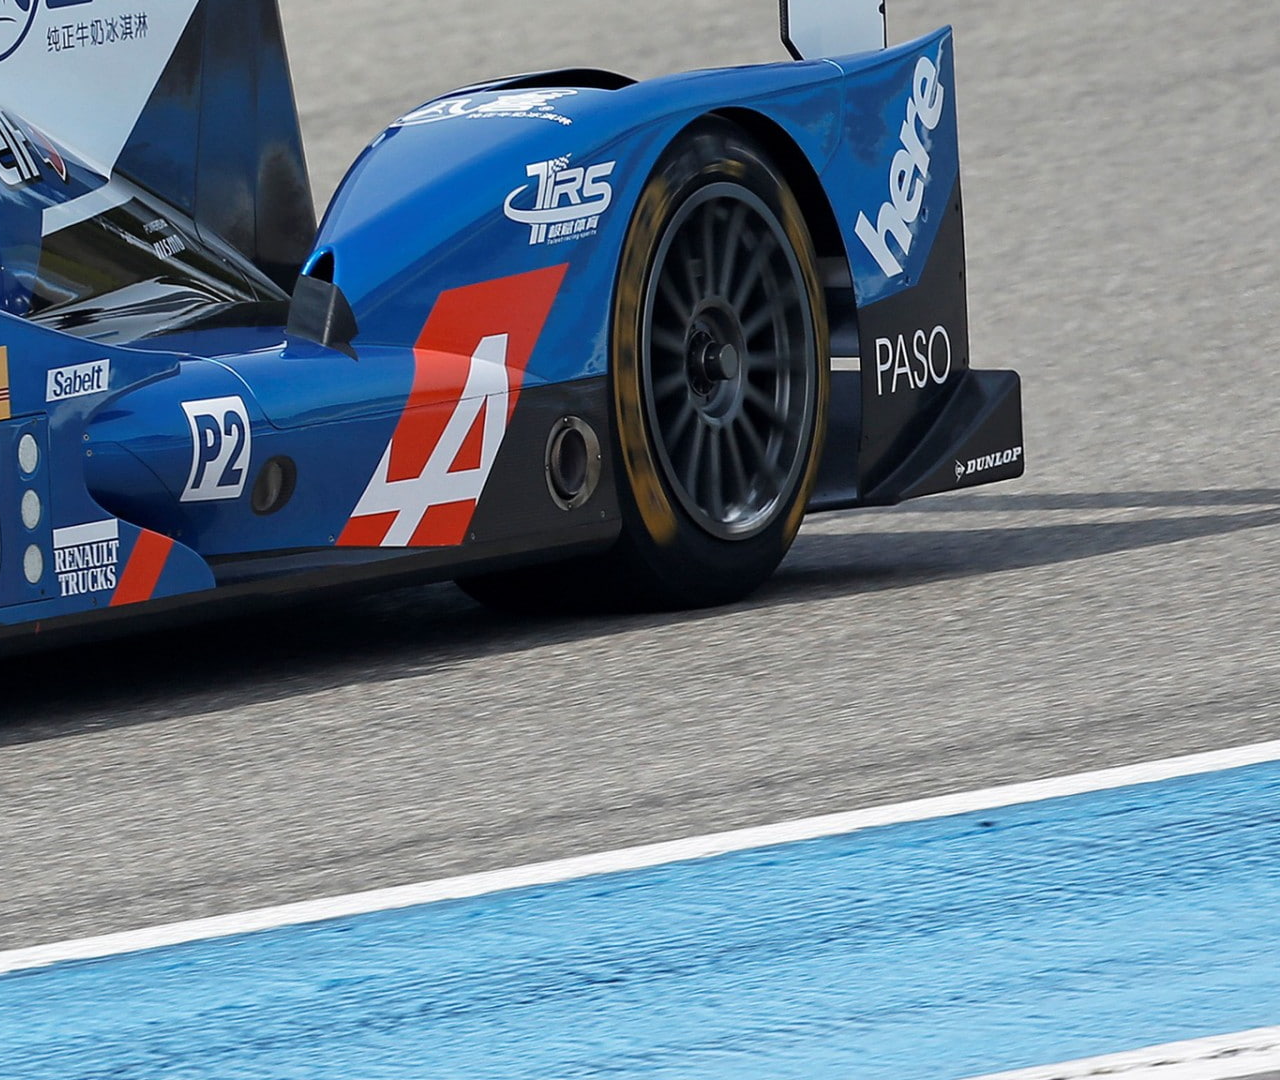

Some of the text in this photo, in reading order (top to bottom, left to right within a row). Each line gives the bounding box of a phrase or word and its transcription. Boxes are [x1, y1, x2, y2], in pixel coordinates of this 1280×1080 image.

[854, 56, 944, 279] here
[874, 324, 951, 396] PASO
[52, 365, 104, 397] Sabelt
[190, 409, 246, 490] P2
[965, 446, 1022, 475] DUNLOP
[53, 540, 120, 573] RENAULT
[58, 565, 117, 597] TRUCKS
